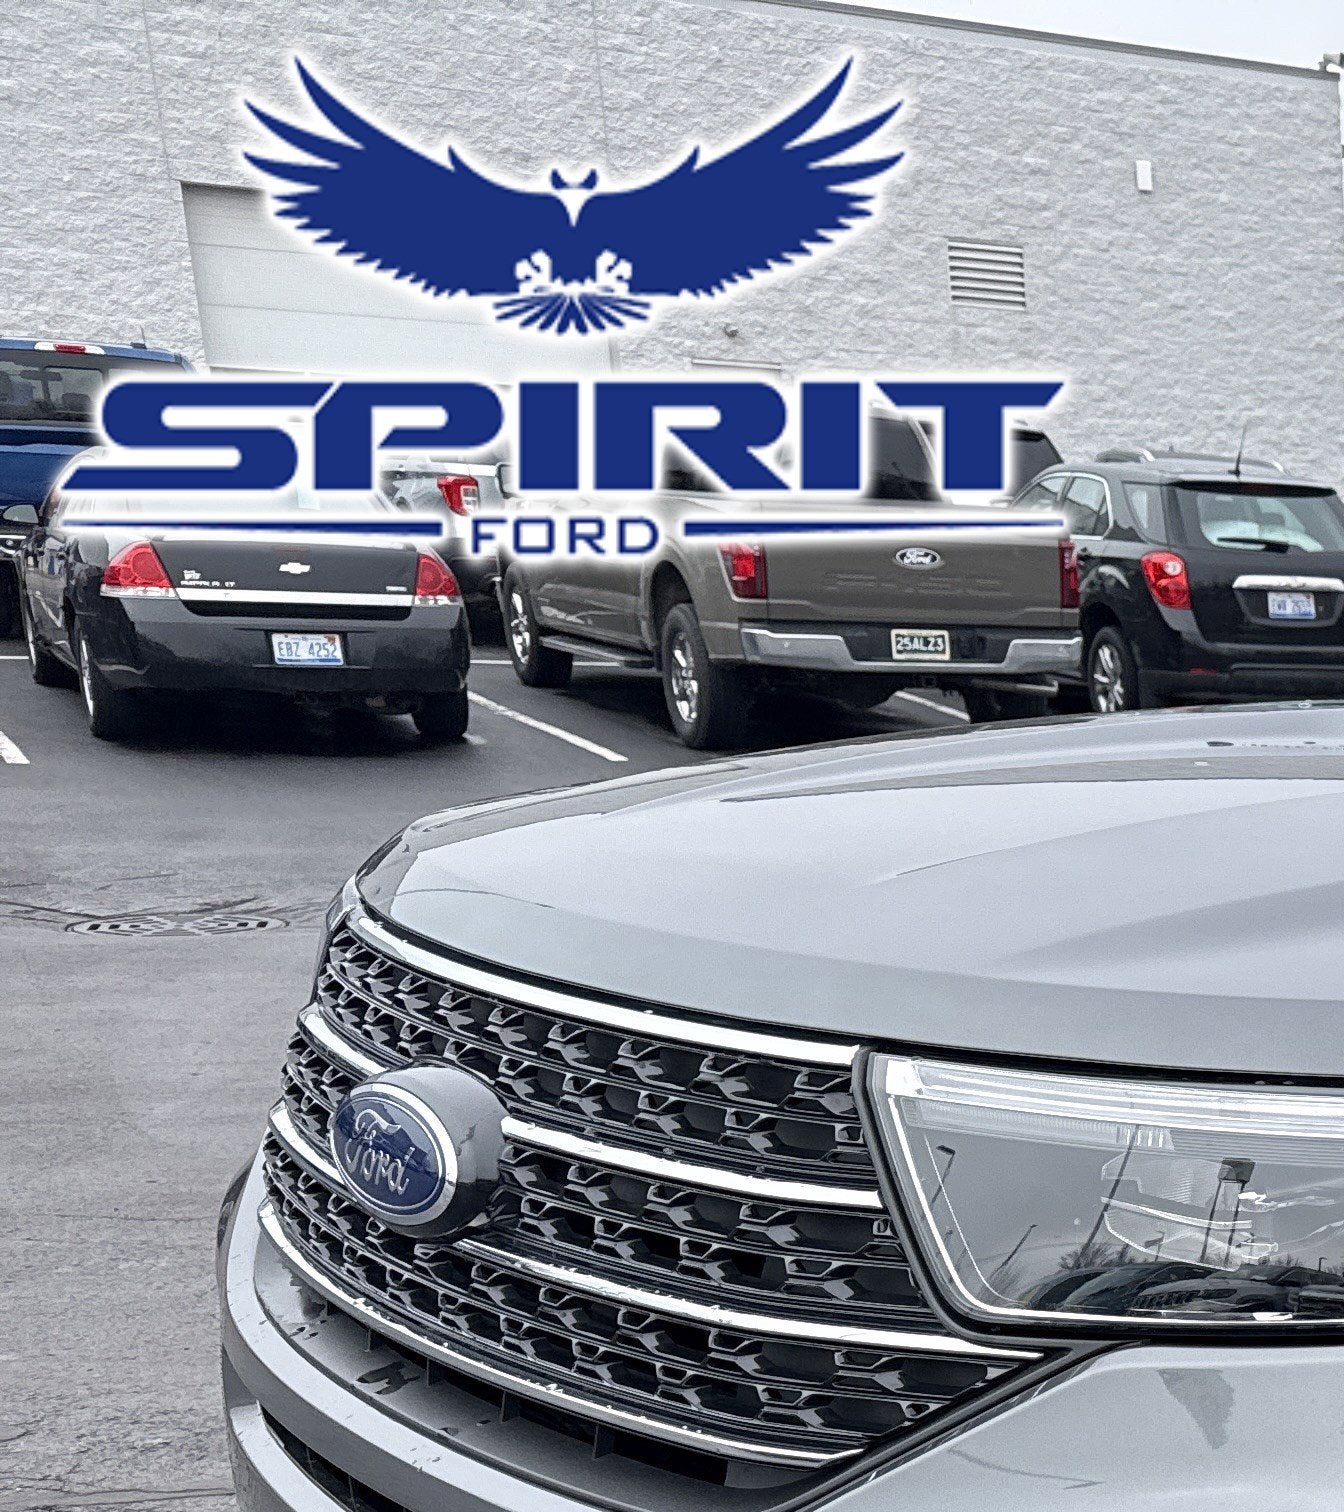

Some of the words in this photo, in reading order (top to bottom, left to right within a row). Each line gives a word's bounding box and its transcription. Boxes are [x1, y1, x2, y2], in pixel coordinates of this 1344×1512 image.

[277, 641, 301, 657] EBZ
[308, 641, 337, 658] 4252
[344, 1108, 416, 1196] Ford
